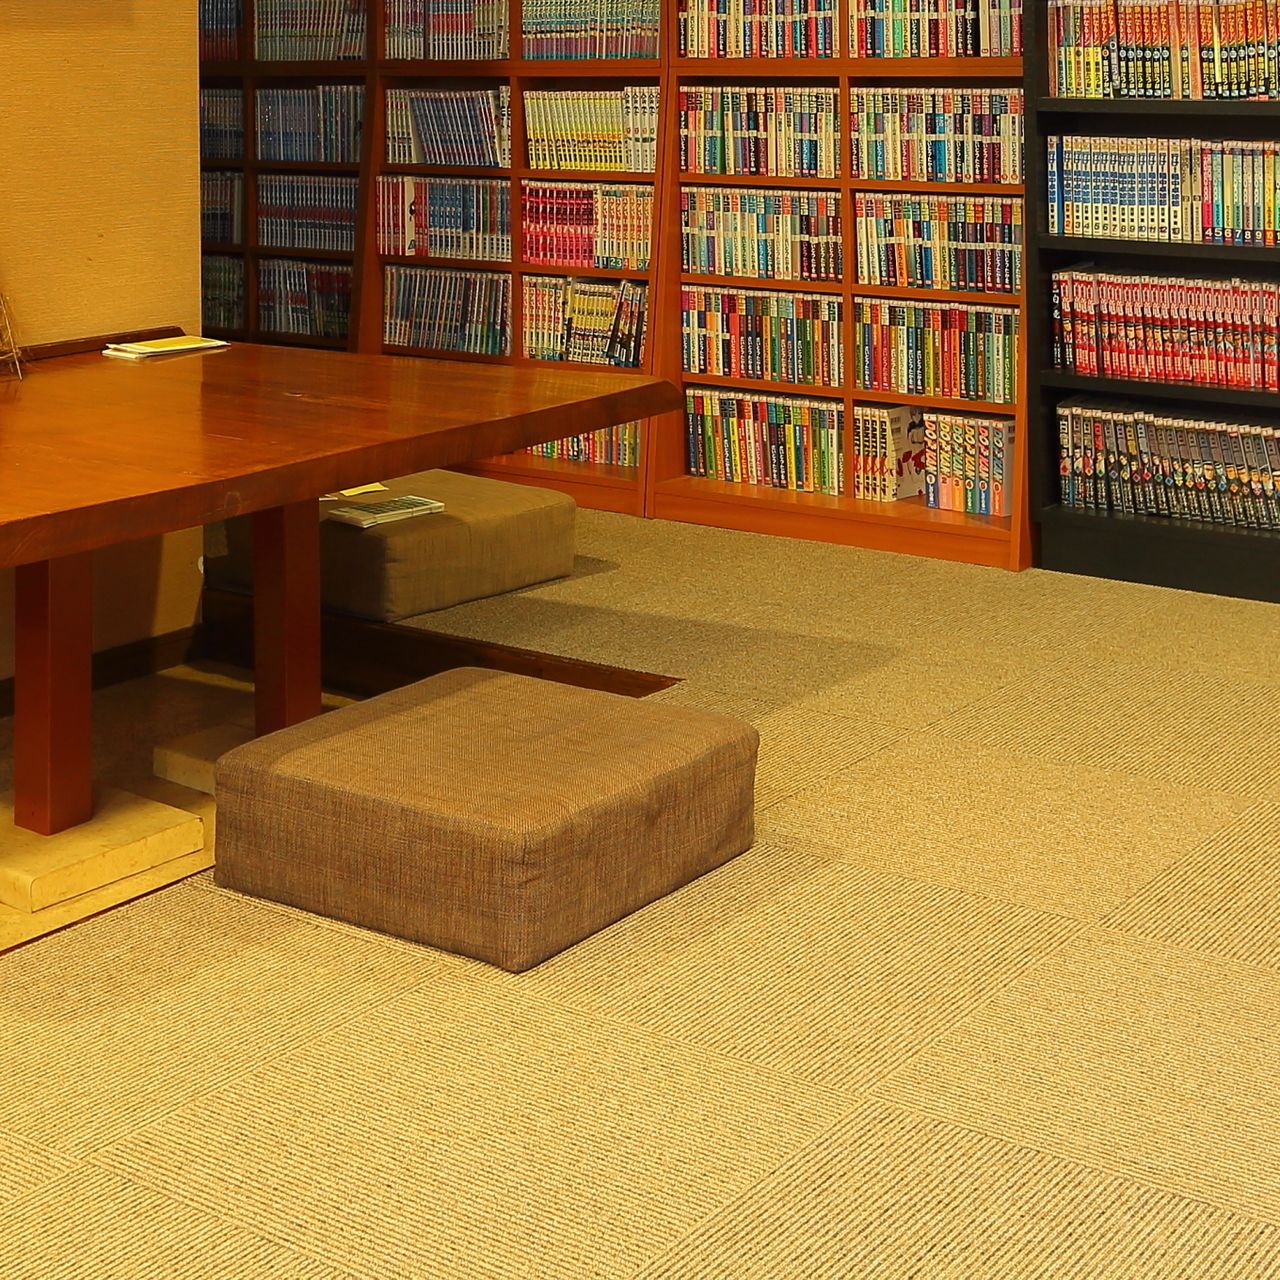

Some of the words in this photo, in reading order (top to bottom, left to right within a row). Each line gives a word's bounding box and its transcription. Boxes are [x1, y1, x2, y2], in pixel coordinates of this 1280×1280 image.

[1205, 228, 1212, 236] 4
[1215, 228, 1222, 236] 5
[1225, 229, 1231, 237] 6
[1236, 230, 1241, 238] 7
[1245, 231, 1251, 239] 8
